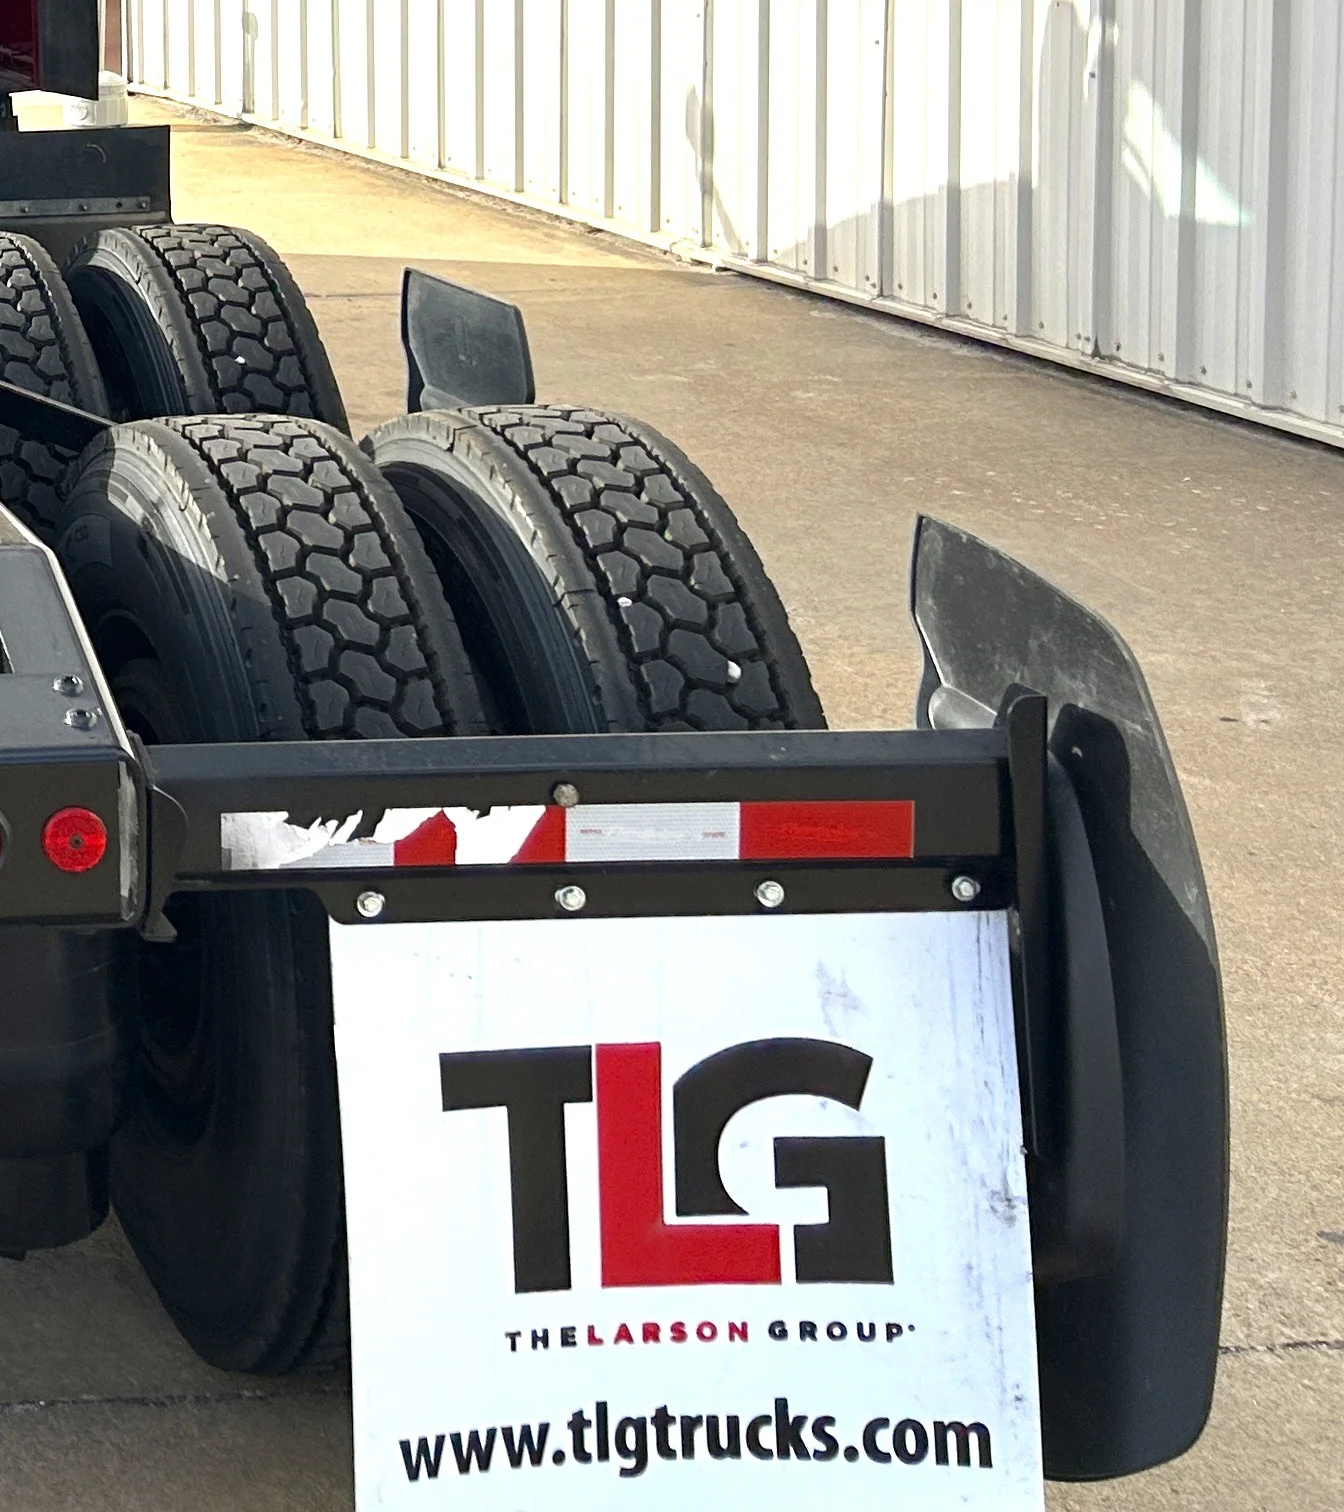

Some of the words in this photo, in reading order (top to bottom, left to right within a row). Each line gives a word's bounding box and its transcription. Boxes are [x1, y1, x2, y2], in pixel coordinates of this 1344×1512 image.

[439, 1036, 894, 1294] TLG
[768, 1320, 904, 1342] GROUP
[399, 1397, 994, 1483] www.tlgtrucks.com
